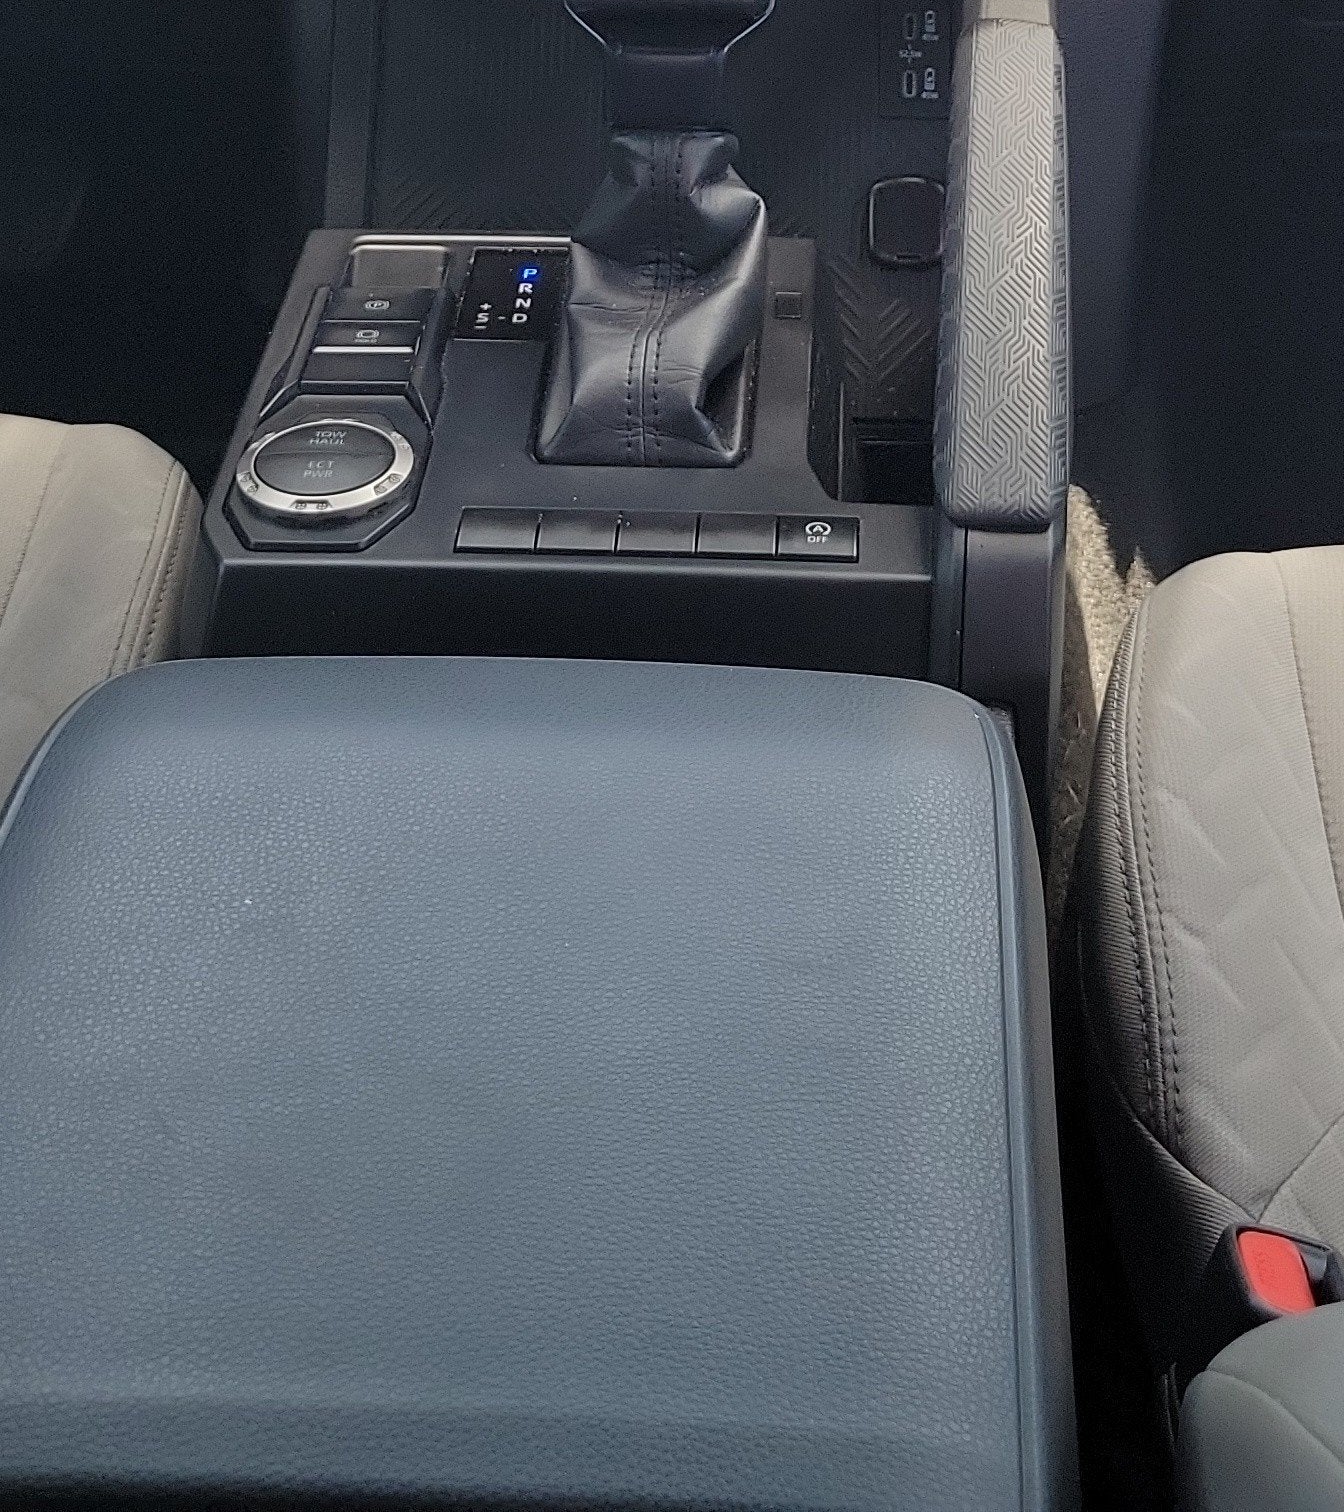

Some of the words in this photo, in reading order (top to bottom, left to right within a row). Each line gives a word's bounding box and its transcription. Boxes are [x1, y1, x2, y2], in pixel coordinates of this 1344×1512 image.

[523, 268, 538, 279] P
[517, 282, 534, 295] R
[515, 297, 532, 309] N
[475, 312, 490, 324] S
[511, 313, 528, 323] D
[307, 460, 335, 469] ECT
[303, 470, 334, 478] PWR
